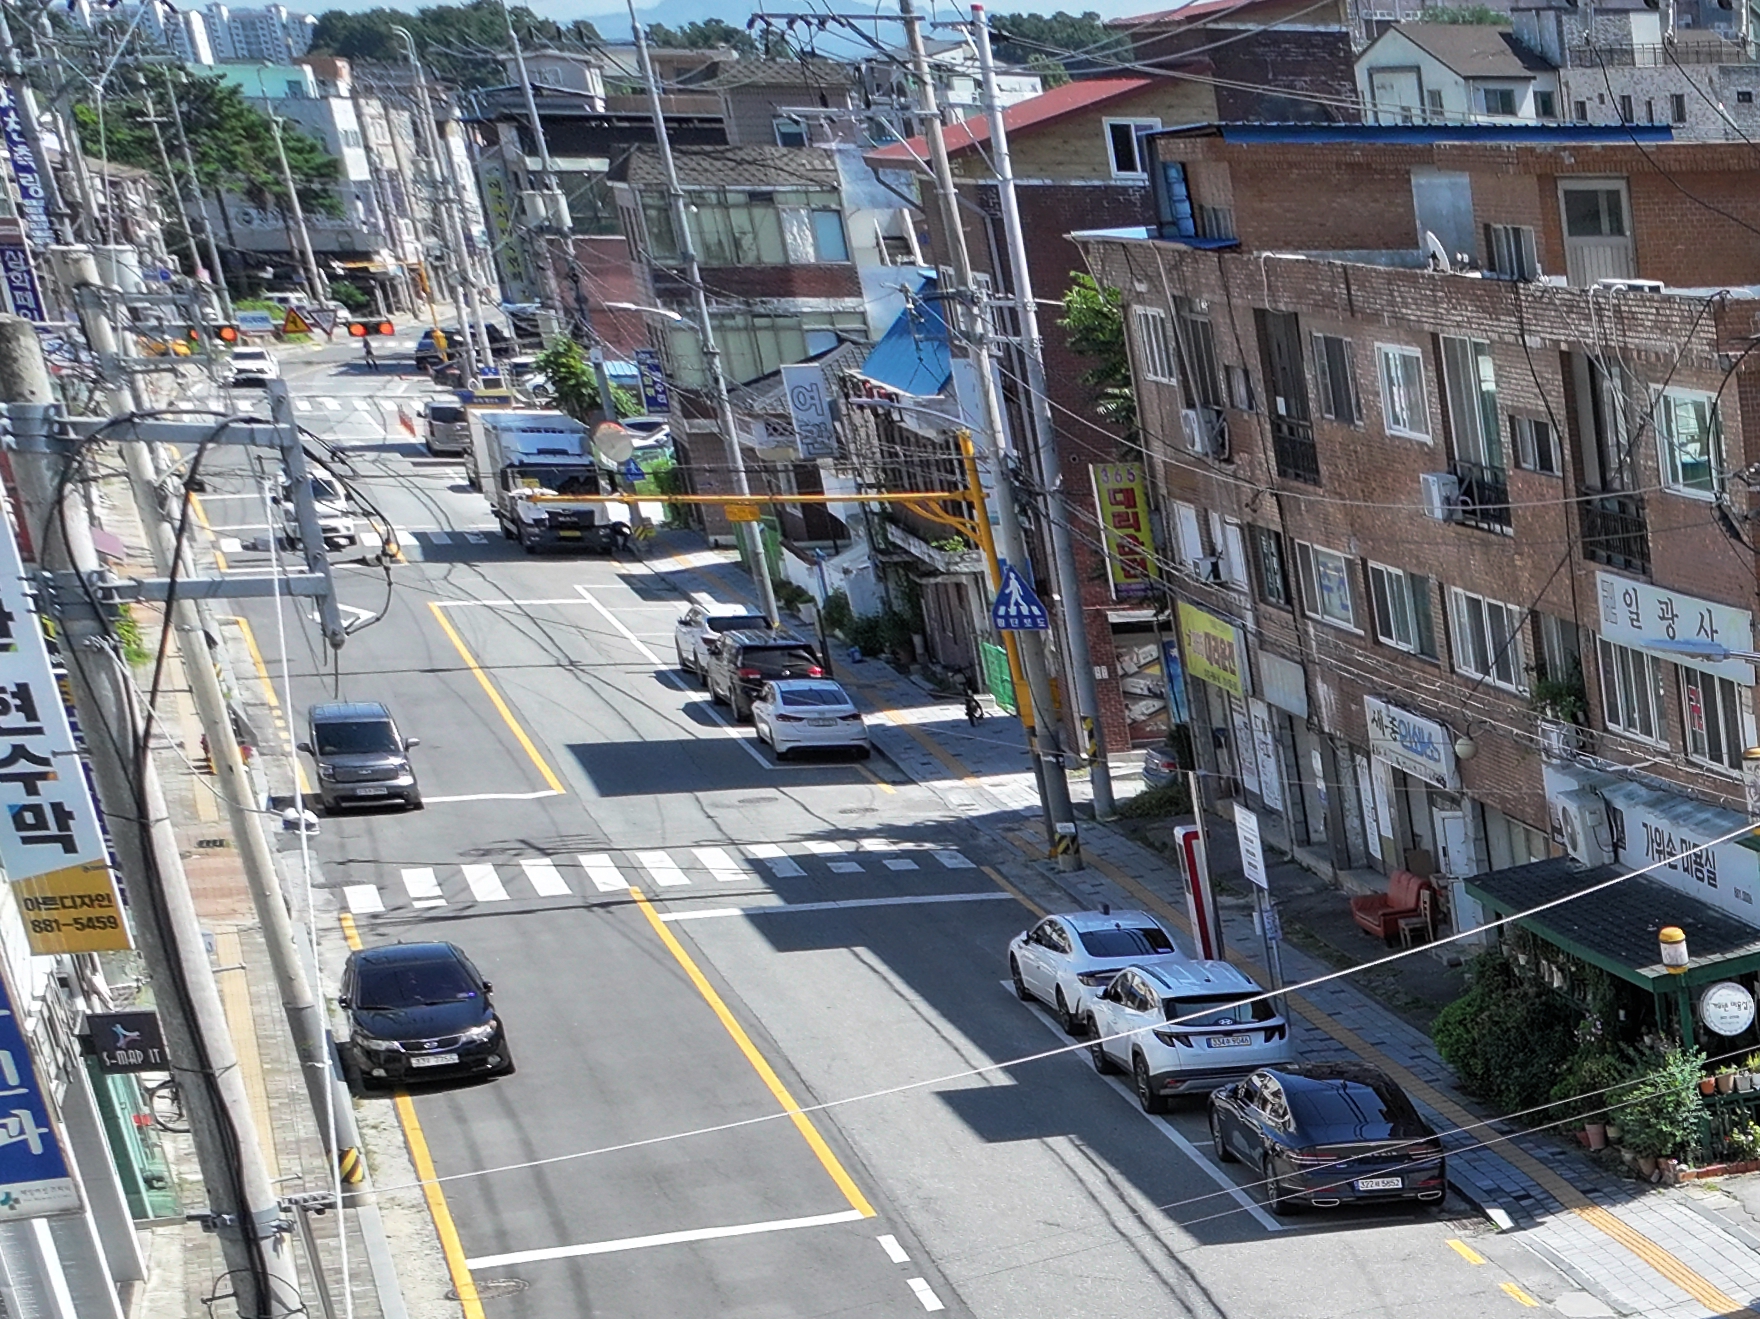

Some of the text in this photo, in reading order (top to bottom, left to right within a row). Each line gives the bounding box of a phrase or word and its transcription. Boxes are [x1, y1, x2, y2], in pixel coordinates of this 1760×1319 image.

[1100, 466, 1136, 484] 365
[1622, 586, 1719, 643] 일광사
[1641, 821, 1718, 890] 가위손 미용실
[23, 893, 114, 912] 아트디자인
[31, 916, 119, 934] 881-5459
[103, 1048, 162, 1067] S-MAP IT
